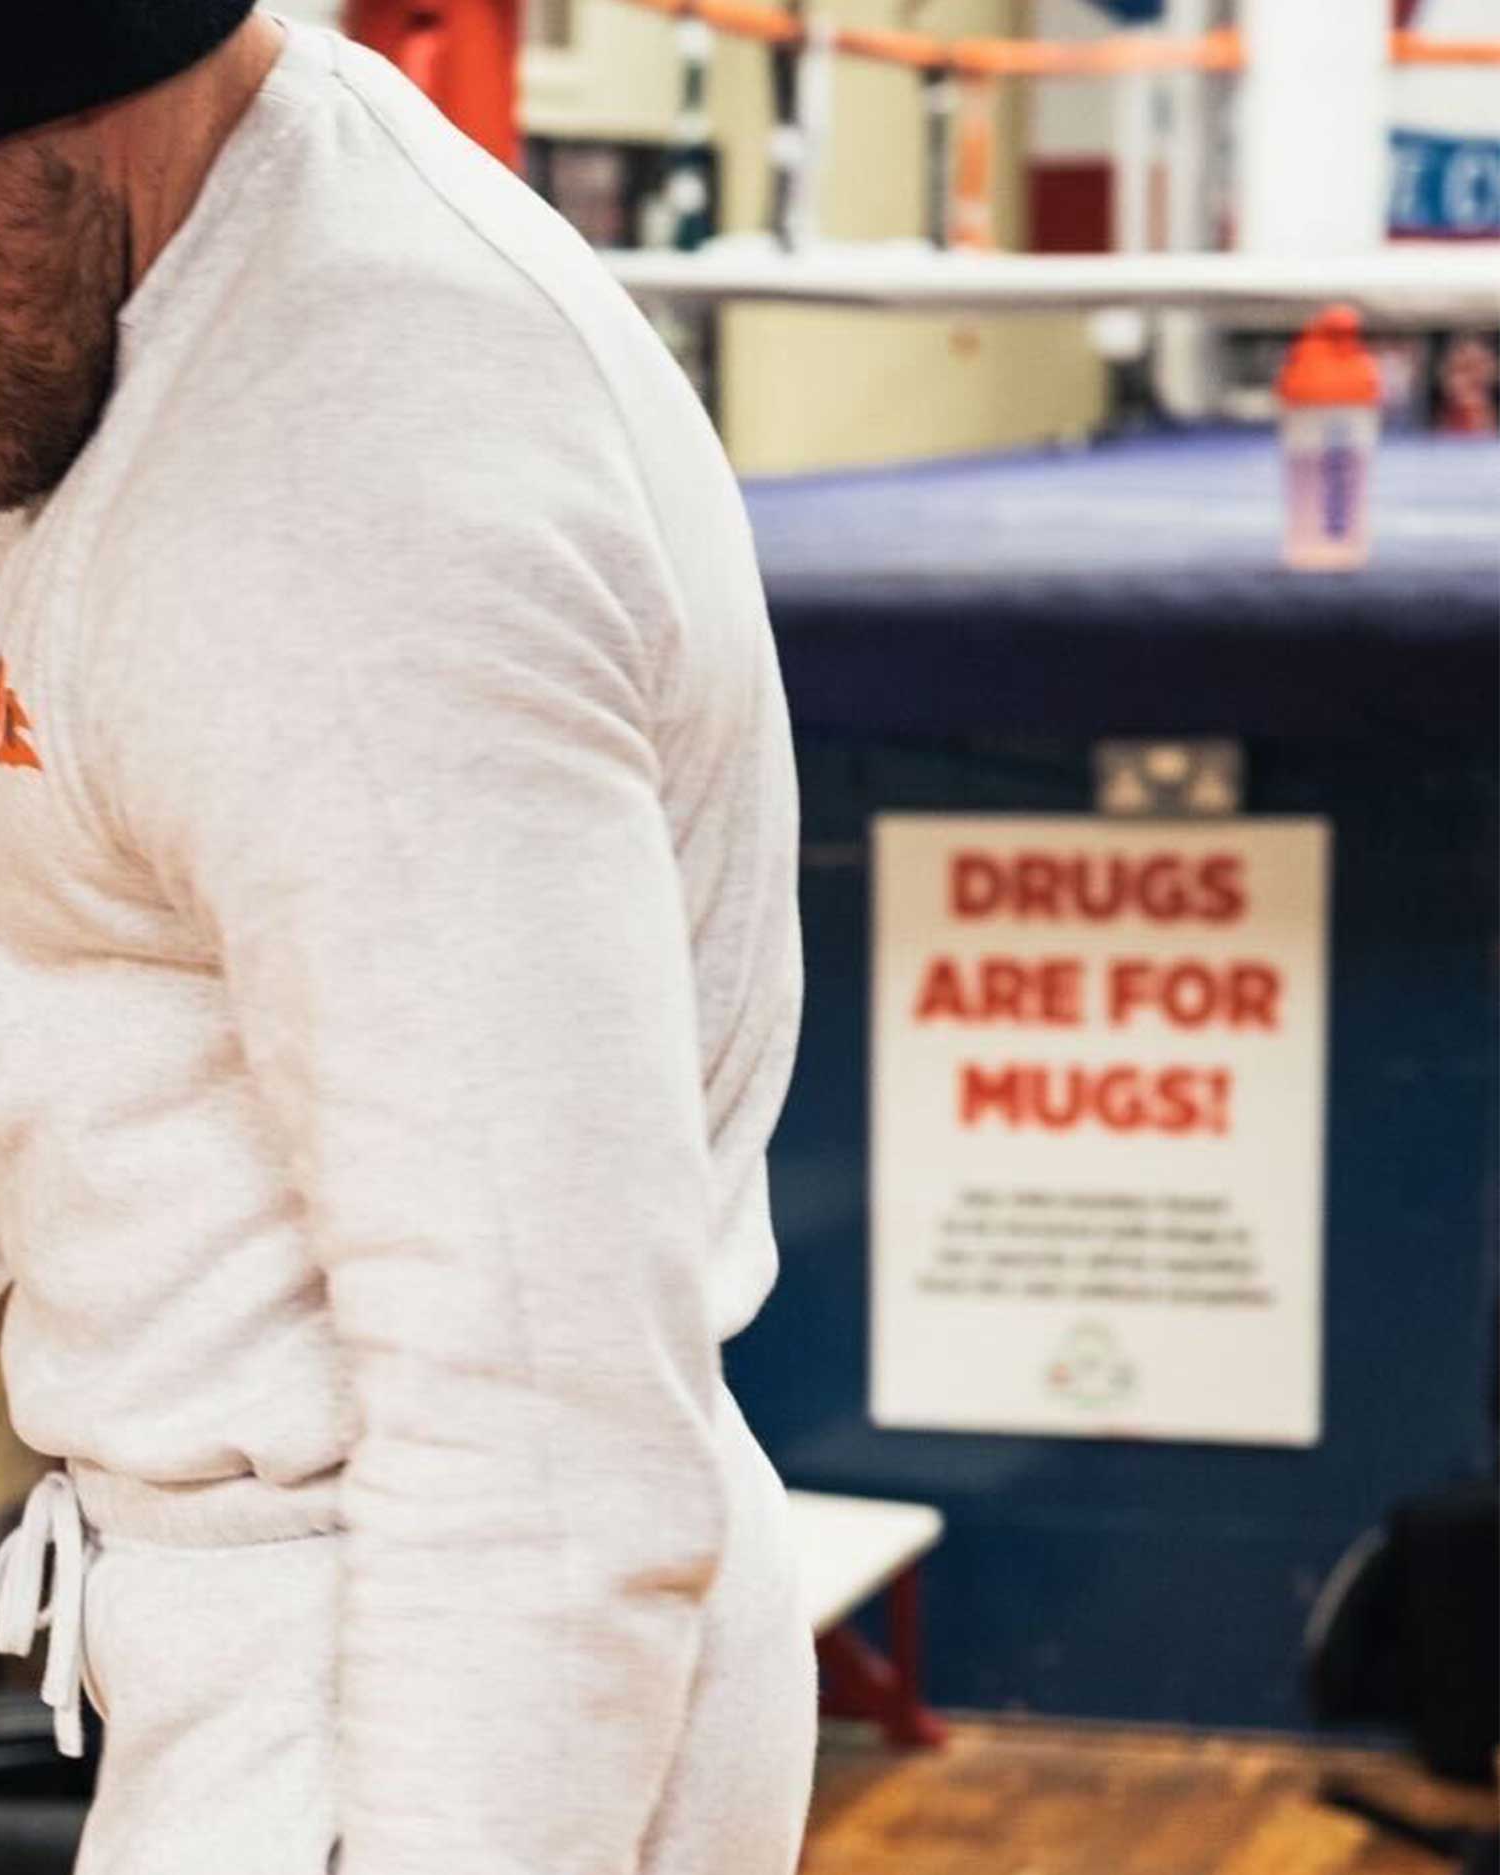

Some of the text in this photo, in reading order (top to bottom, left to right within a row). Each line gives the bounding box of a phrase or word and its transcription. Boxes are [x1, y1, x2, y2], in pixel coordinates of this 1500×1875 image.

[947, 850, 1248, 924] DRUGS
[913, 955, 1284, 1033] ARE FOR
[955, 1063, 1233, 1137] MUGS!
